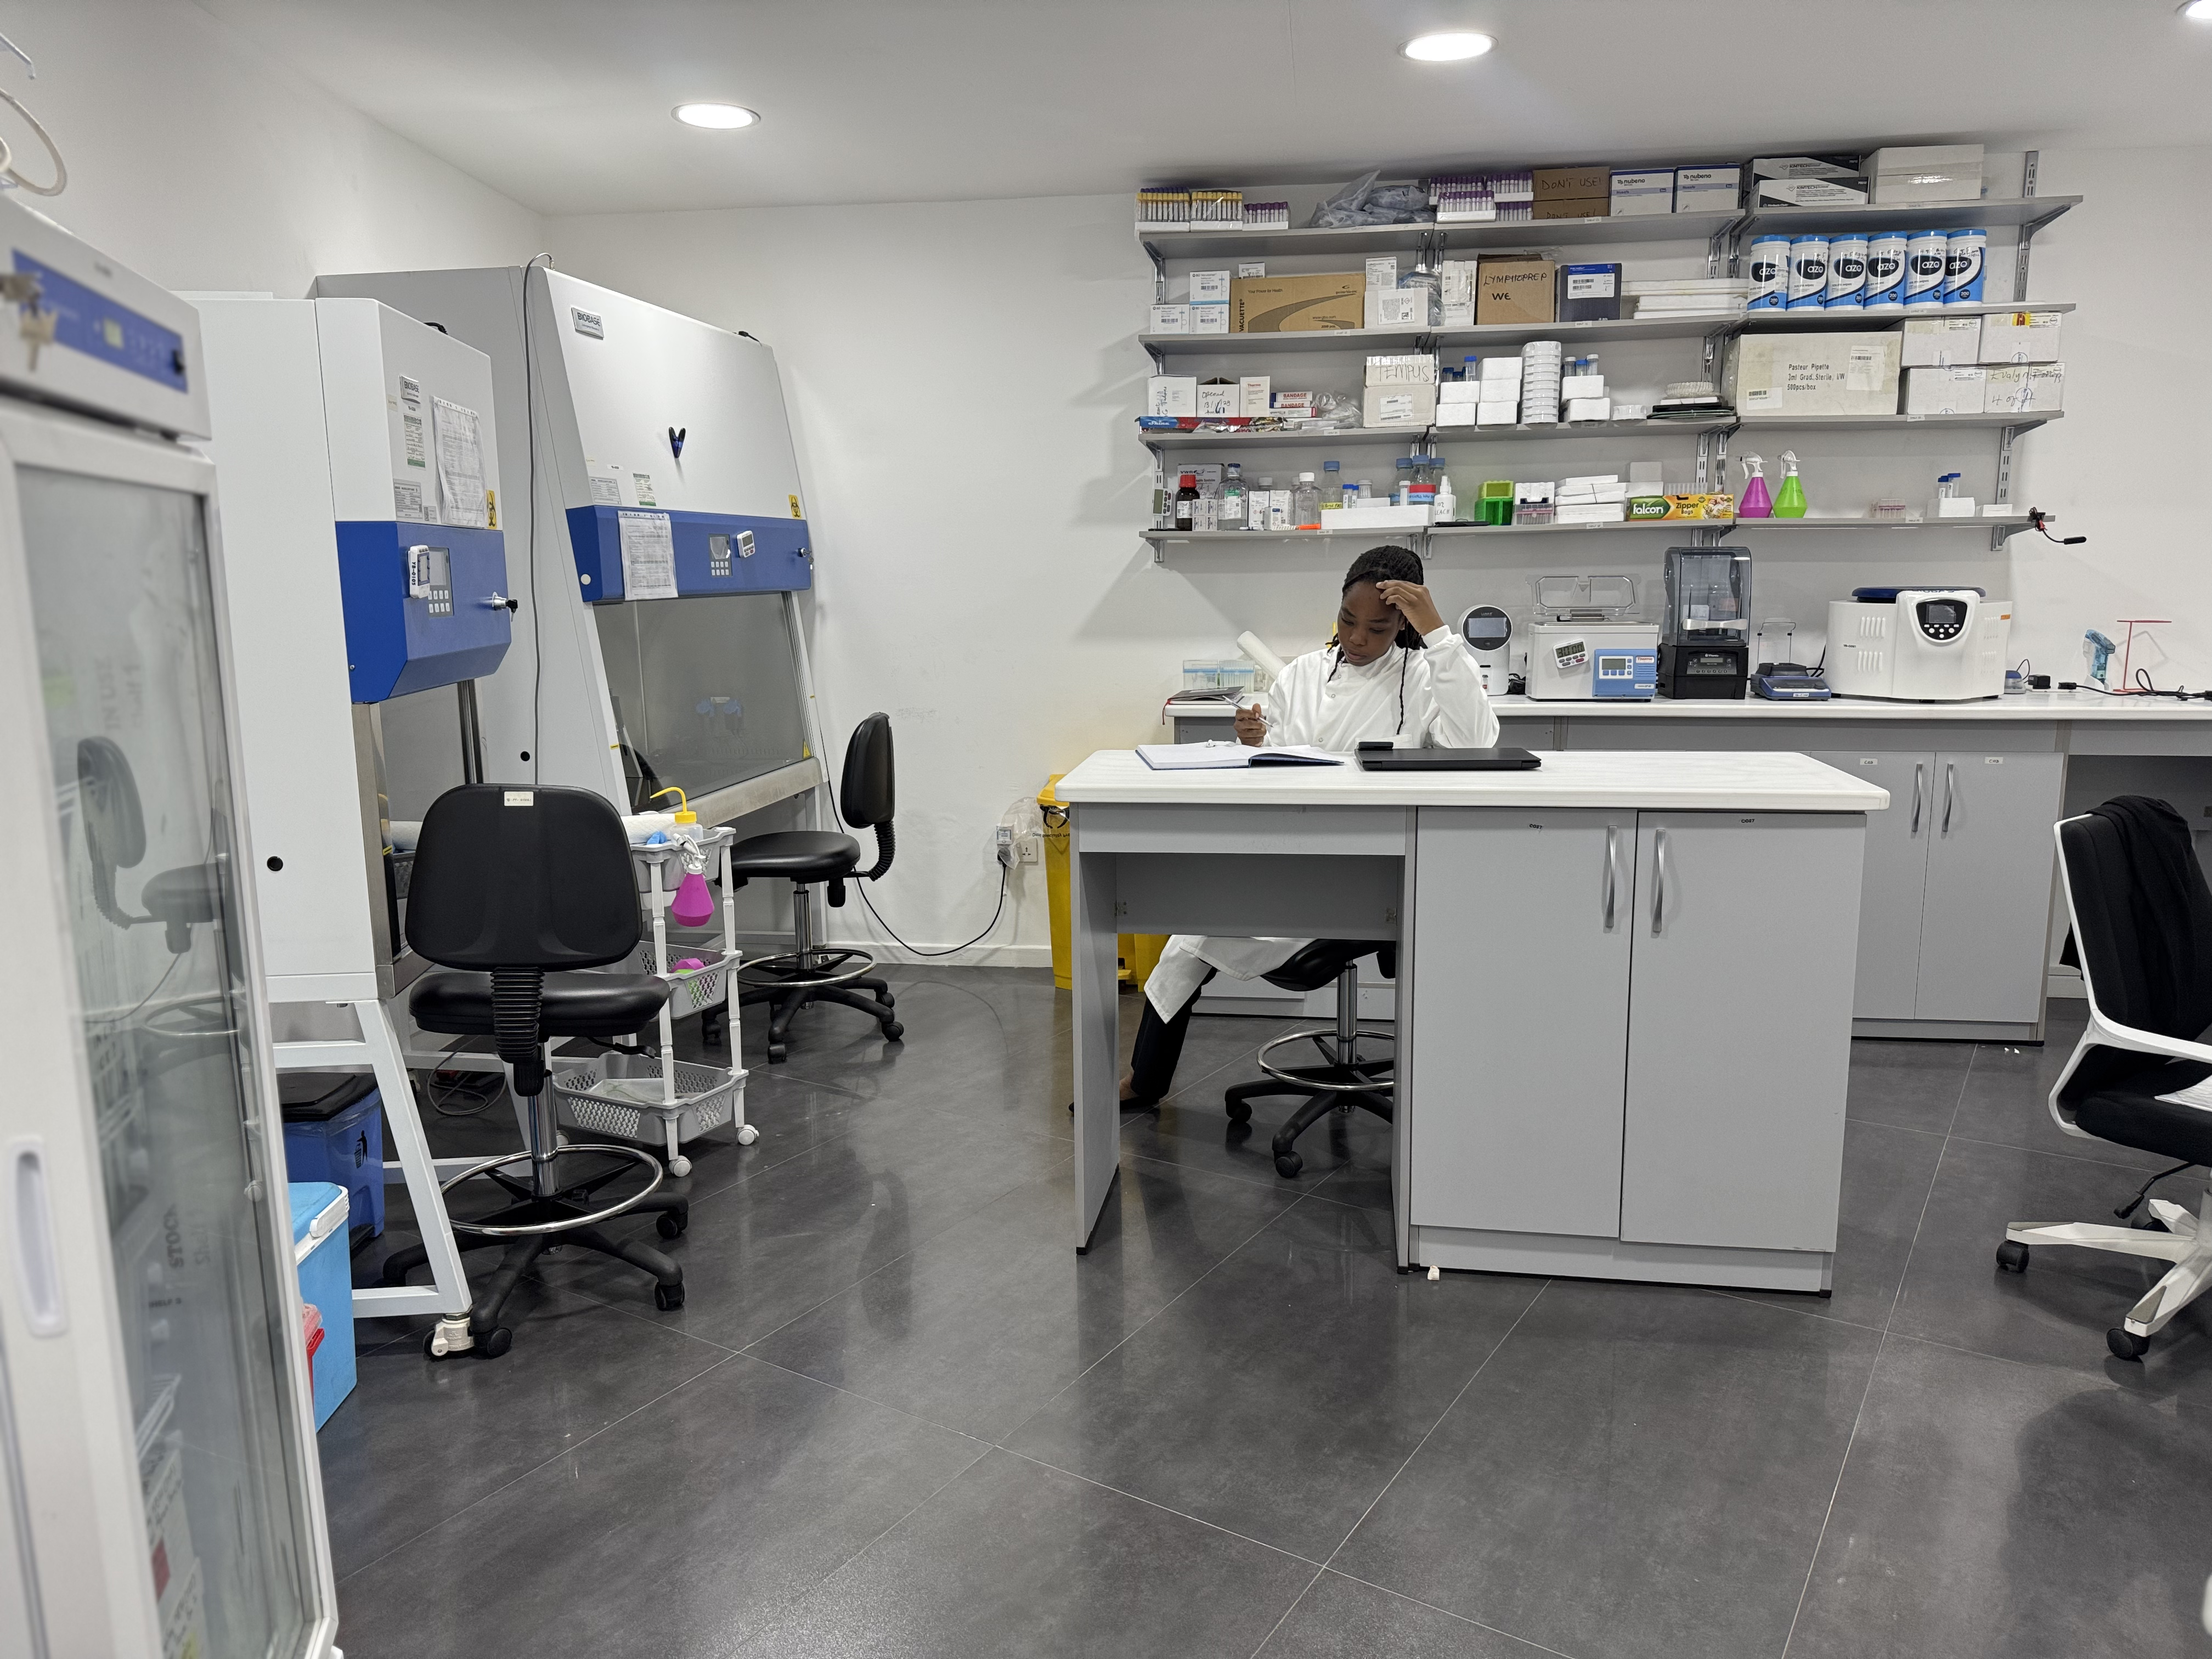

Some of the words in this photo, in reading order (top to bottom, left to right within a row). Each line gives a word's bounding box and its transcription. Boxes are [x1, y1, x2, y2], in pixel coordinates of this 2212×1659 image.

[1542, 178, 1574, 190] DON'T
[1580, 177, 1601, 187] USE!
[1949, 261, 1968, 269] azo
[1492, 292, 1511, 301] WE
[577, 312, 601, 326] BIOBASE
[1375, 363, 1429, 382] TEMPUS
[1633, 503, 1664, 515] falcon
